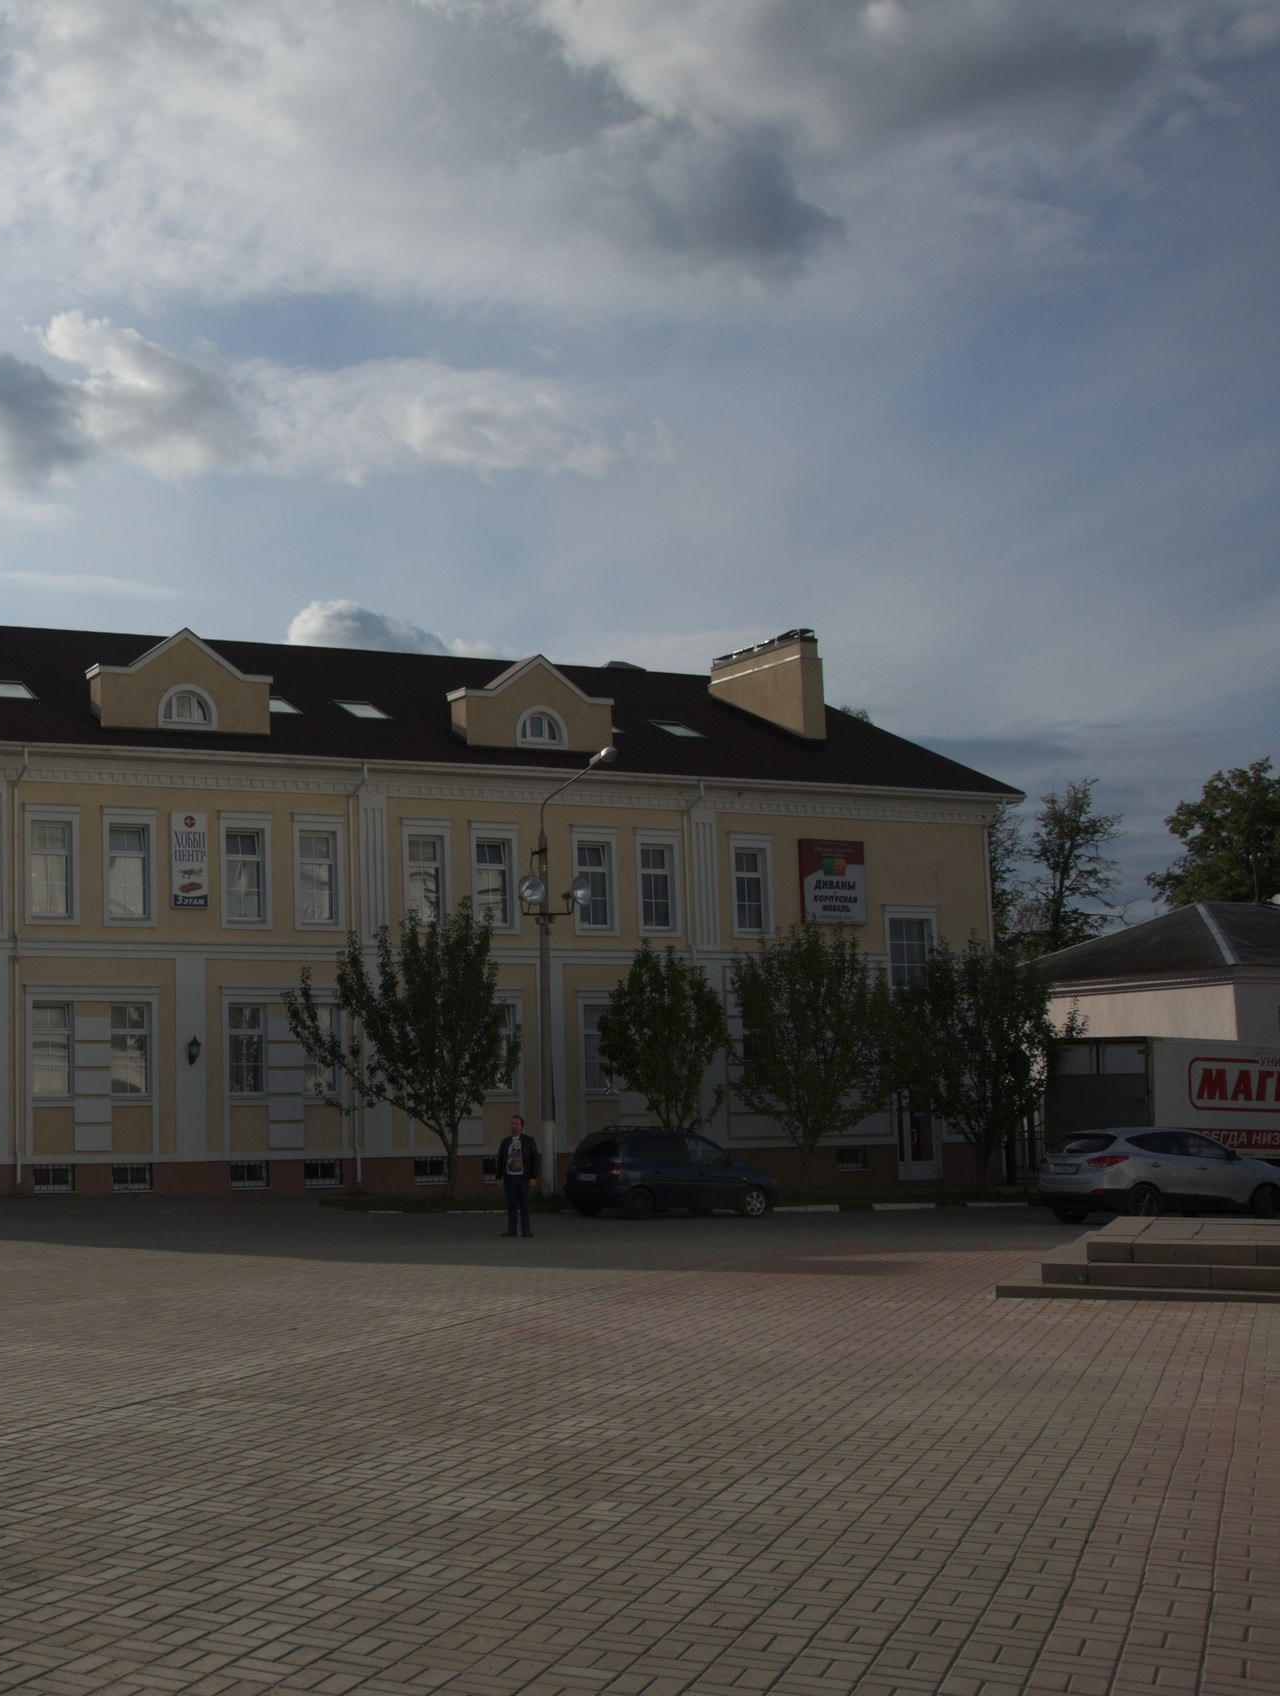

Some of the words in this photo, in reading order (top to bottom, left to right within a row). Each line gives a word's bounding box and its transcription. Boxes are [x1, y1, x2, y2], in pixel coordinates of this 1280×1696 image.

[174, 831, 206, 848] ХОББИ
[174, 849, 206, 863] ЦЕНТР
[814, 880, 856, 891] ДИВАНЫ
[813, 895, 858, 904] КОРПУСНАЯ
[821, 904, 852, 913] МЕБЕЛЬ
